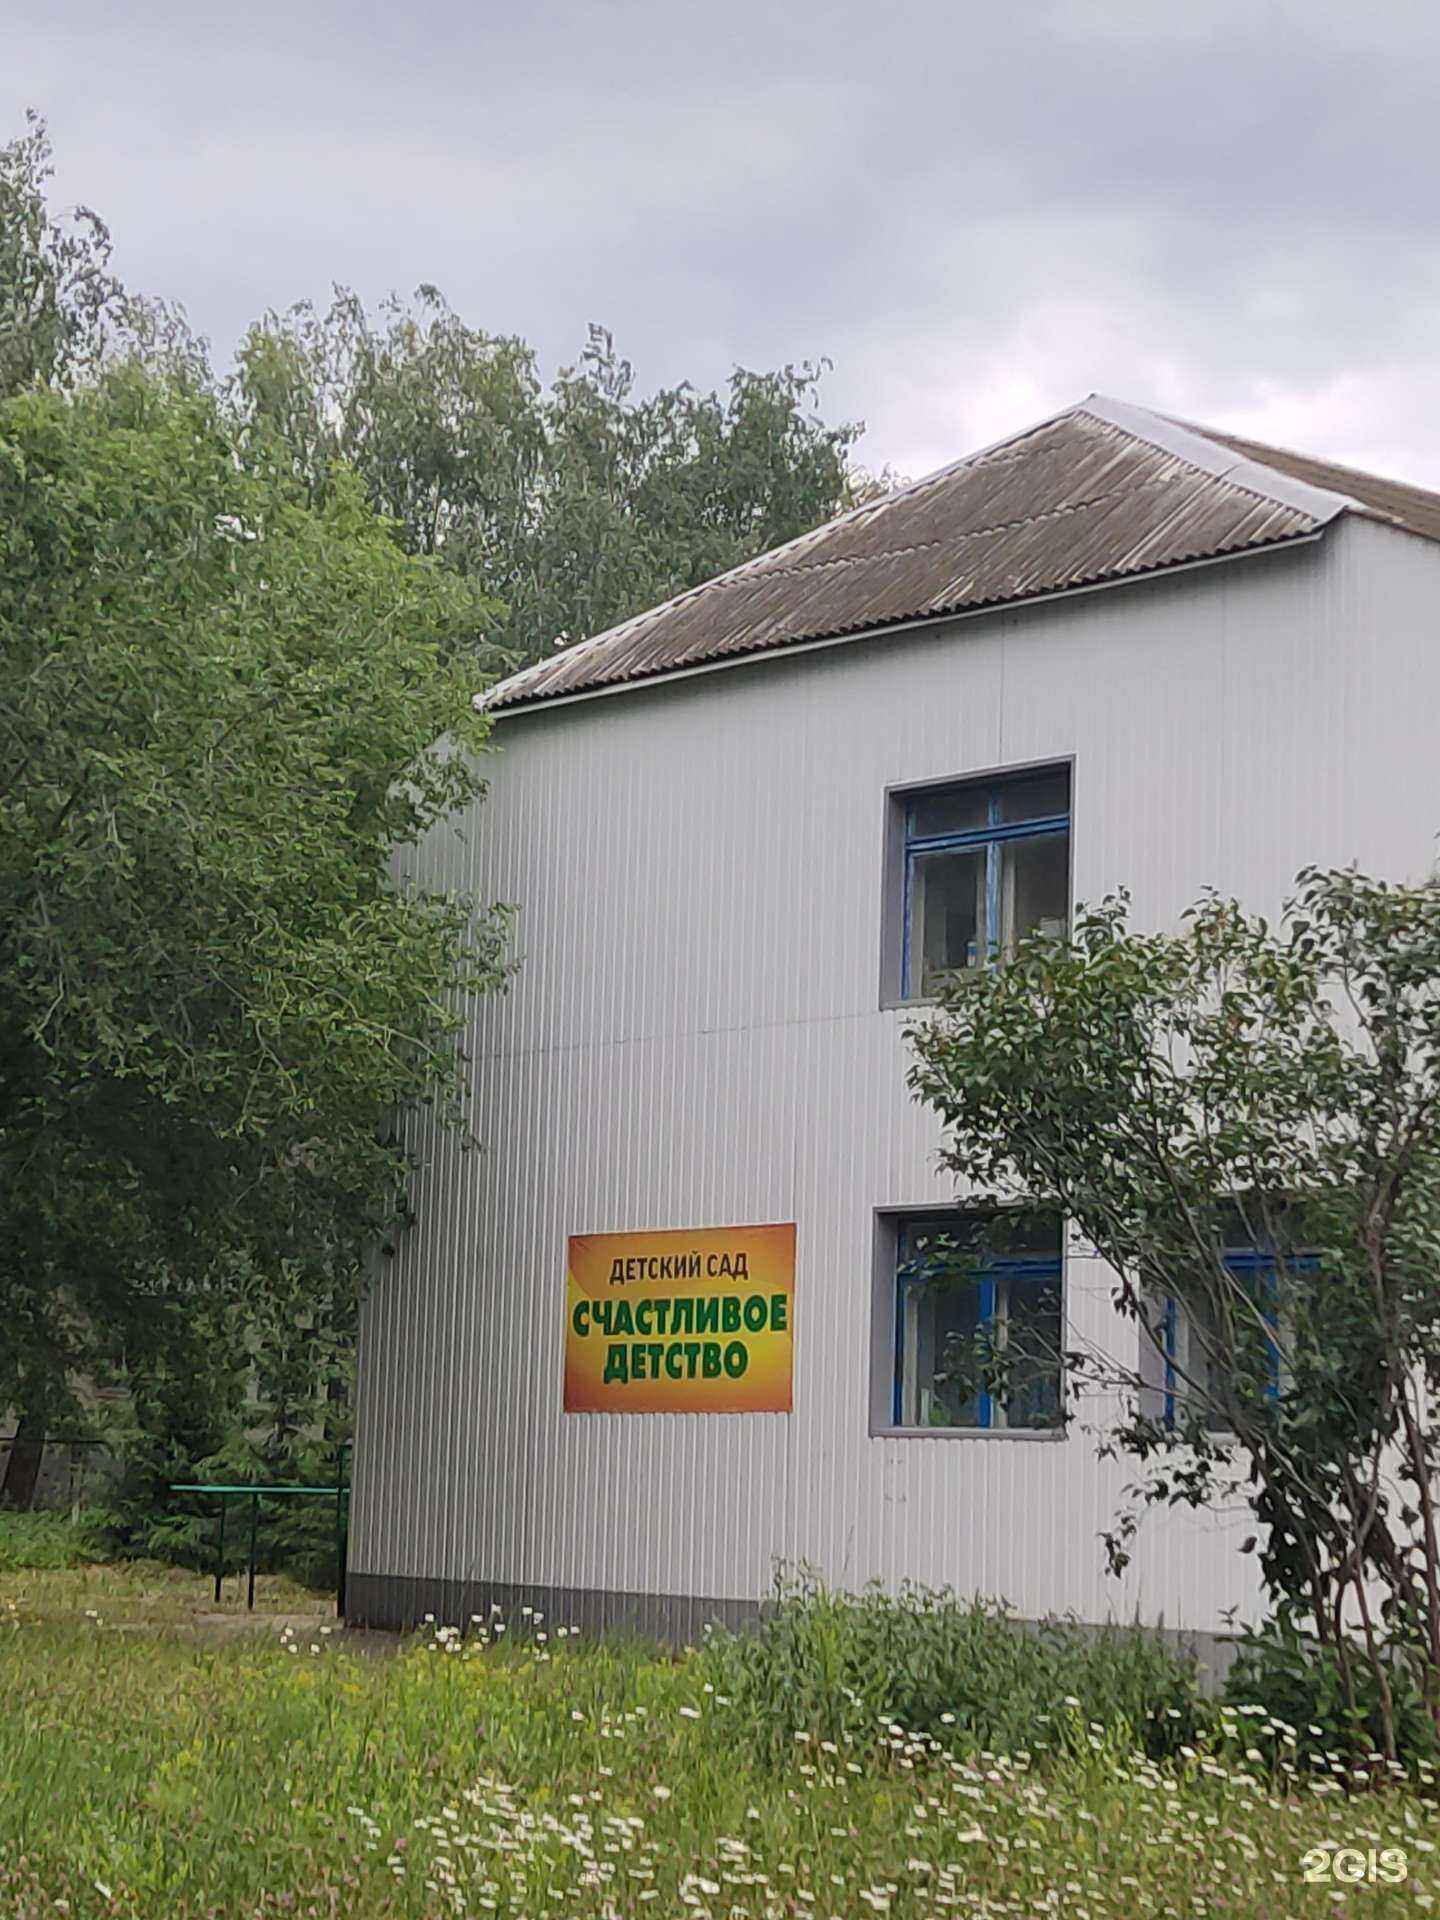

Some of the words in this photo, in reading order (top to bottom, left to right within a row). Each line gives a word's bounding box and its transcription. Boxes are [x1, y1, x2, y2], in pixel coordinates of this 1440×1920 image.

[609, 1251, 701, 1285] ДЕТСКИЙ
[707, 1252, 748, 1280] САД
[573, 1294, 787, 1336] СЧАСТЛИВОЕ
[603, 1340, 748, 1384] ДЕТСТВО
